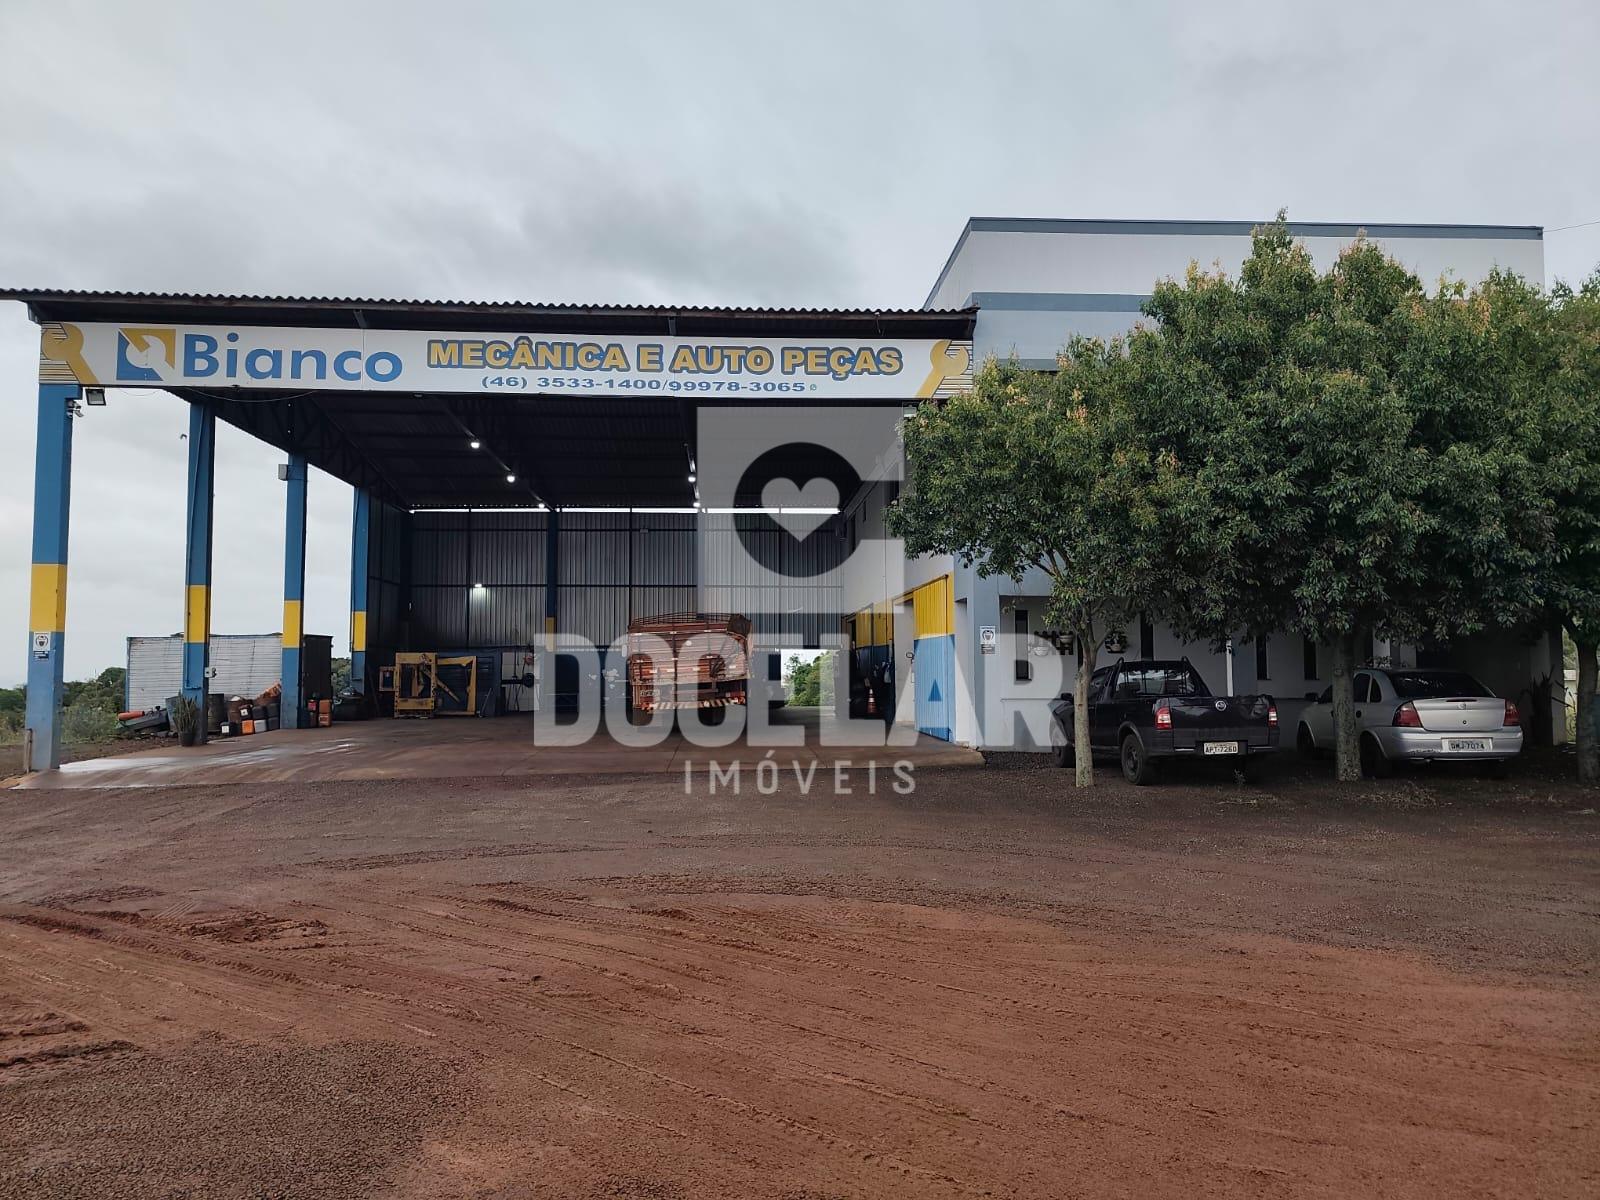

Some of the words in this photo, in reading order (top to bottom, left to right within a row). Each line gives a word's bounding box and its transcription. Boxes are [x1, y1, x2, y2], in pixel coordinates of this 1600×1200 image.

[183, 332, 402, 382] Bianco
[427, 336, 631, 372] MECÂNICA
[637, 343, 664, 373] E
[668, 345, 774, 375] AUTO
[780, 347, 904, 381] PEÇAS
[481, 376, 528, 389] (46)
